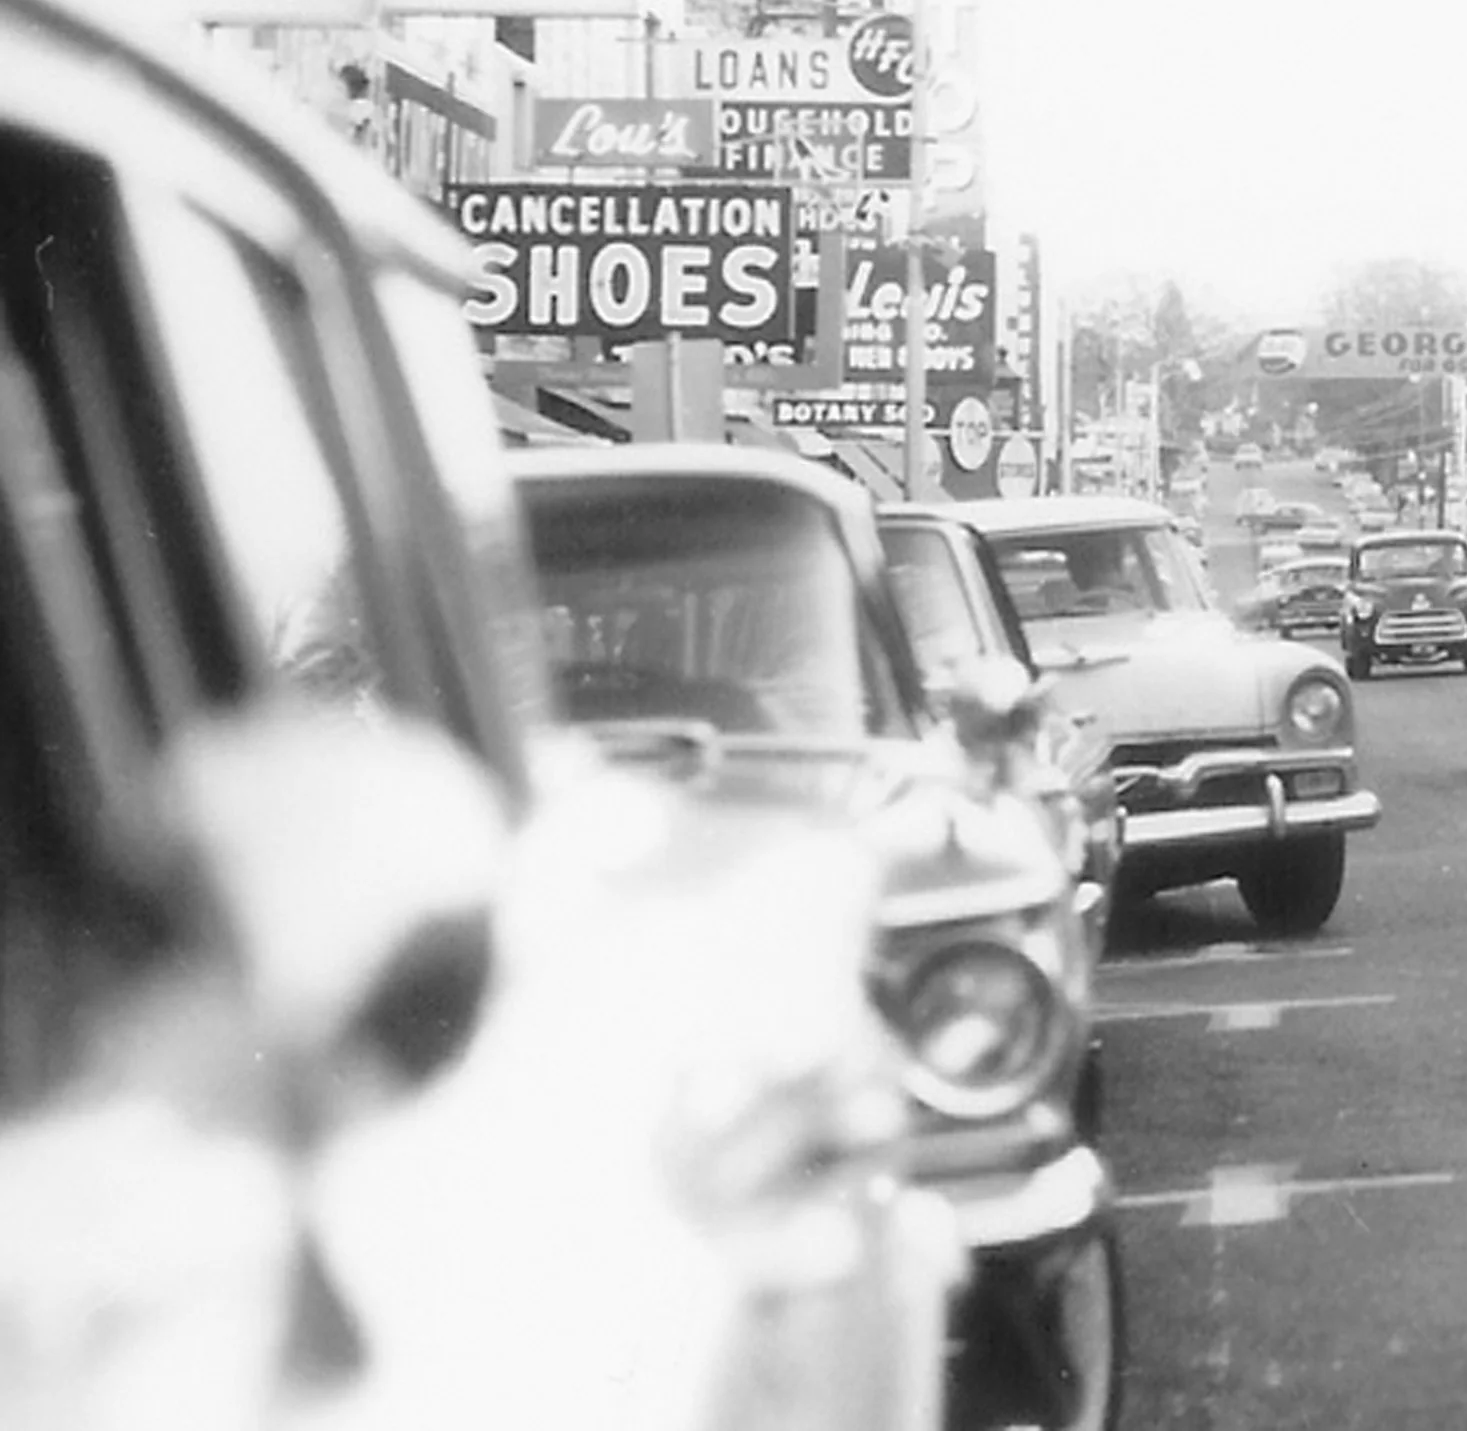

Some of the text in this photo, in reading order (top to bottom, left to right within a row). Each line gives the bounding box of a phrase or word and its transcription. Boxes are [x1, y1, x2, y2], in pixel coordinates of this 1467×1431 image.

[695, 49, 830, 90] LOANS
[551, 103, 700, 159] Lou's
[720, 108, 913, 137] OUSEHOLD
[460, 193, 781, 236] CANCELLATION
[462, 241, 779, 328] SHOES
